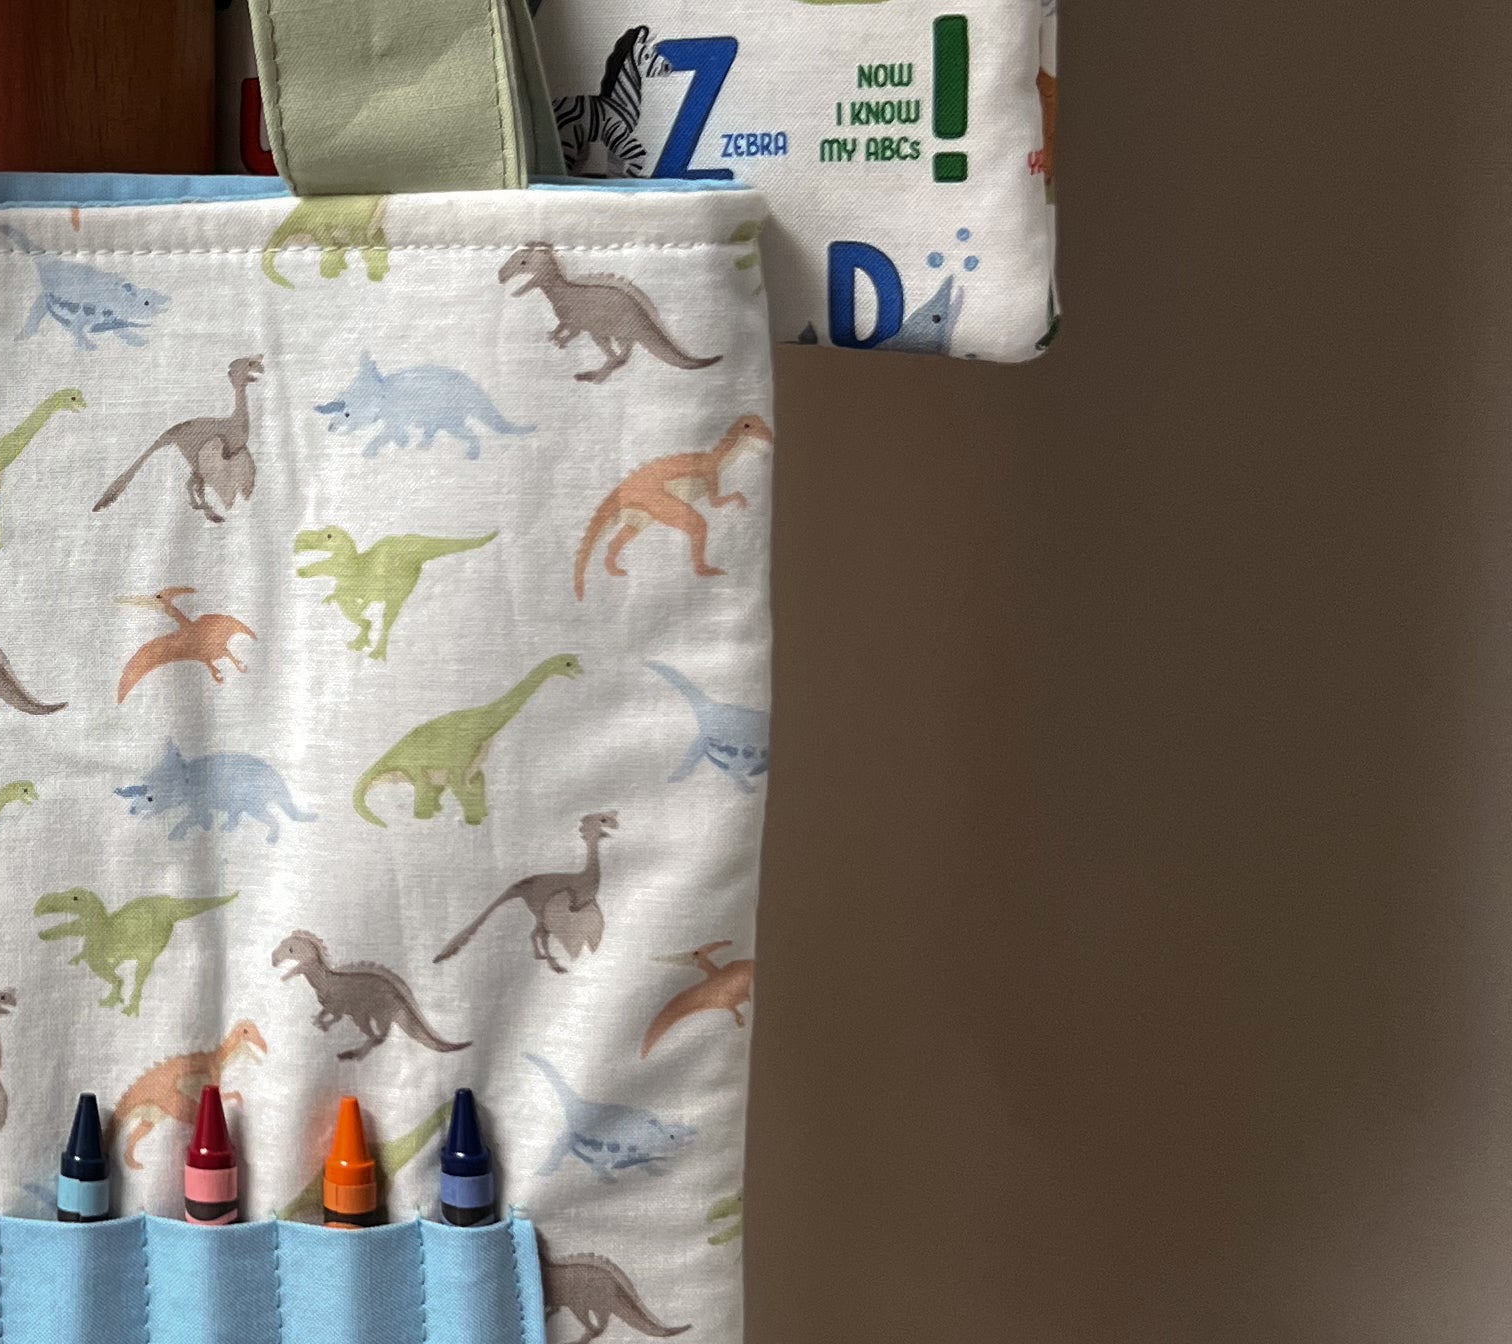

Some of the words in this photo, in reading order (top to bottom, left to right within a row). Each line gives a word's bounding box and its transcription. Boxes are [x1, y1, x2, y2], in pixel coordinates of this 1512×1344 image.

[858, 63, 913, 88] NOW
[650, 36, 739, 180] Z
[836, 101, 842, 126] I
[850, 99, 920, 126] KNOW
[721, 132, 788, 158] ZEBRA
[820, 137, 857, 163] MY
[865, 136, 921, 161] ABCs
[828, 241, 904, 349] D
